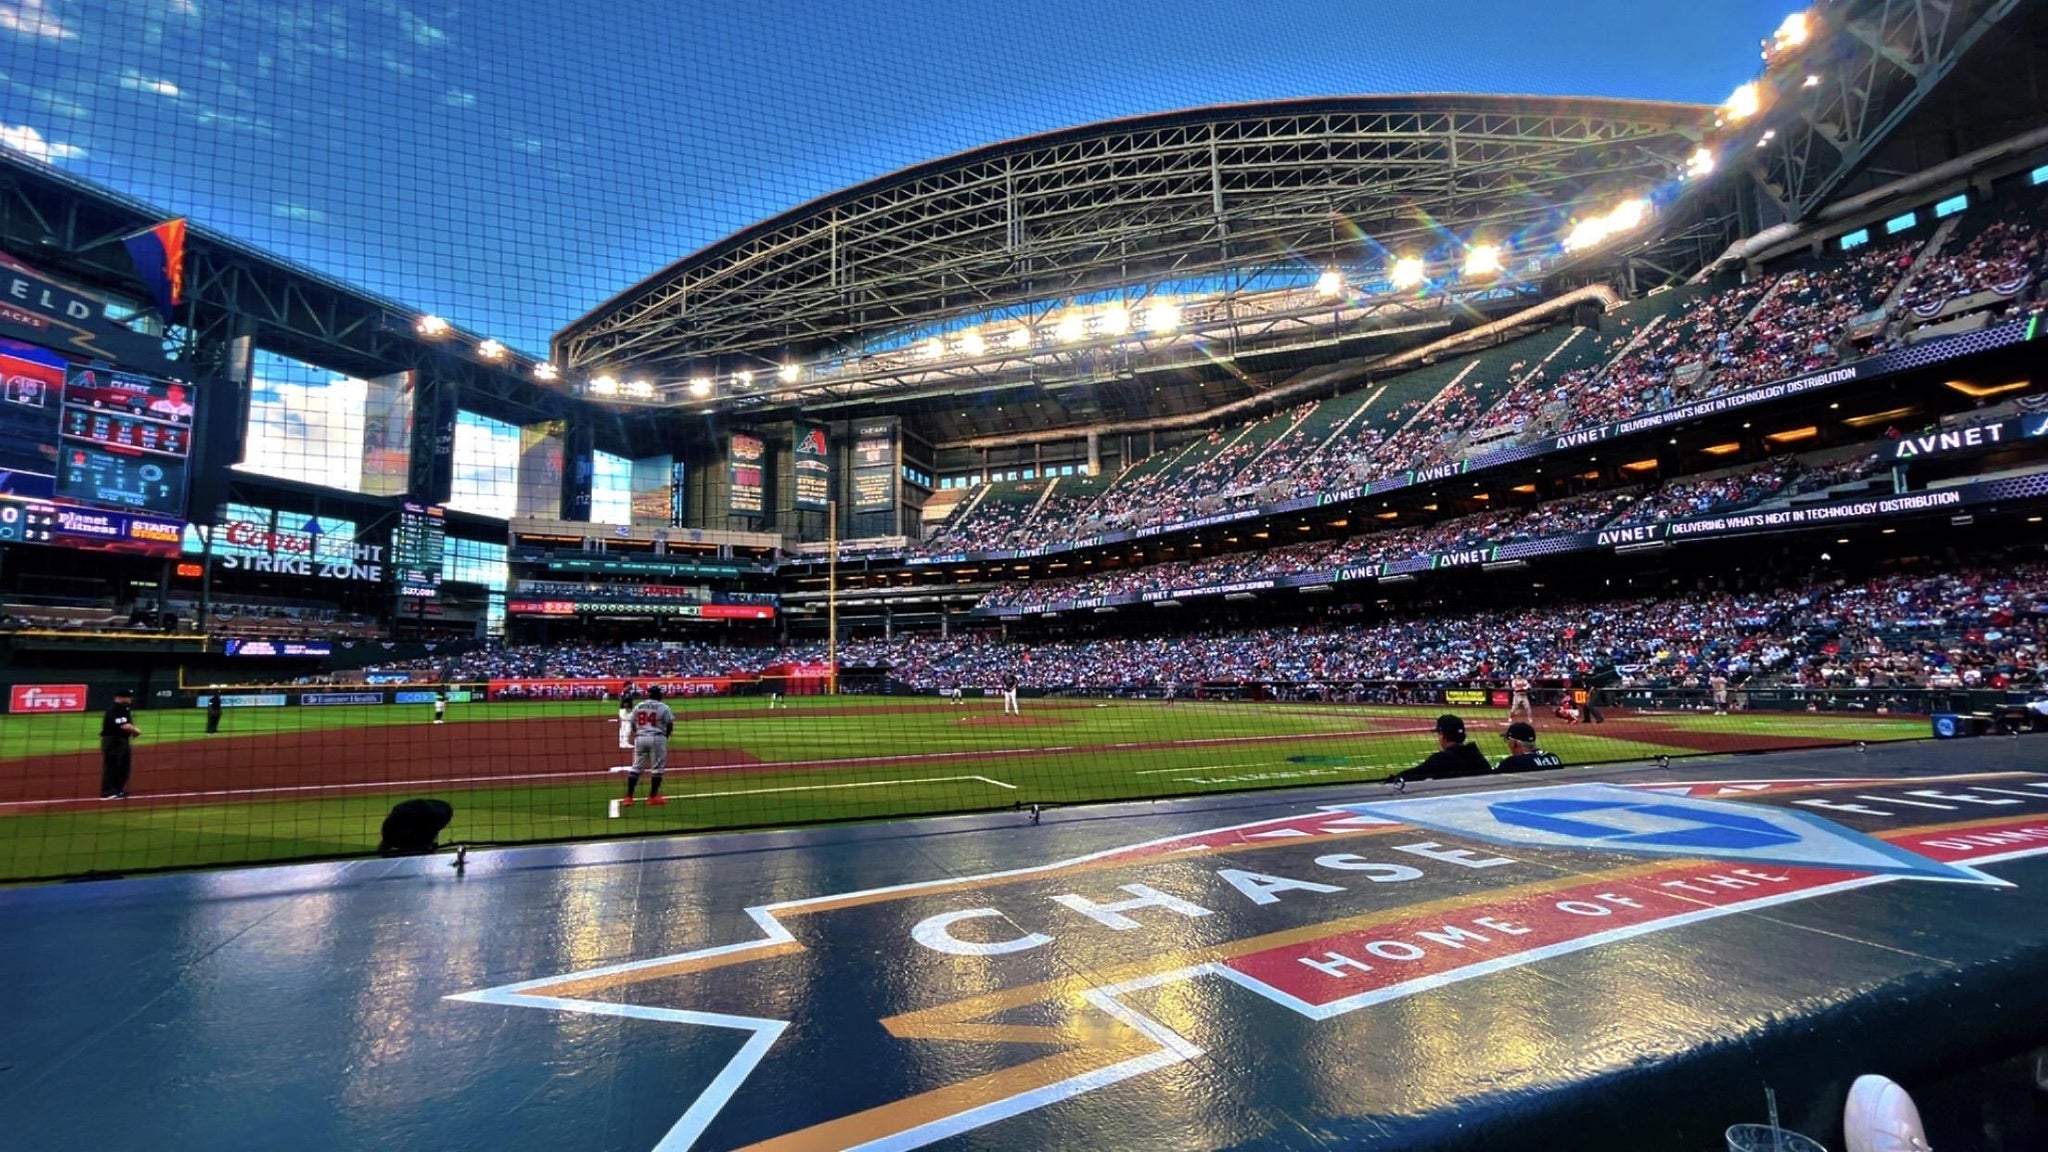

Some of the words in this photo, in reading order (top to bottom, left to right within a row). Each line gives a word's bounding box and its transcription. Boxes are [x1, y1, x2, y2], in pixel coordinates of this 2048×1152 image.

[1556, 426, 1610, 449] AVNET
[1620, 415, 1662, 433] DELIVERING
[1664, 405, 1694, 422] WHAT'S
[1695, 401, 1715, 415] NEXT
[1716, 399, 1726, 410] IN
[1727, 384, 1785, 407] TECHNOLOGY
[1787, 367, 1856, 393] DISTRIBUTION
[1896, 424, 2003, 457] AVNET
[1417, 462, 1461, 483] AVNET
[1323, 487, 1362, 504] AVNET
[132, 521, 180, 534] START
[1598, 525, 1658, 545] AVNET
[1672, 519, 1725, 534] DELIVERING
[1726, 515, 1763, 528] WHAT'S
[1765, 512, 1791, 524] NEXT
[1793, 511, 1804, 522] IN
[1806, 502, 1877, 520] TECHNOLOGY
[1880, 491, 1959, 512] DISTRIBUTION
[222, 551, 312, 576] STRIKE
[318, 562, 382, 582] ZONE
[1440, 549, 1490, 567] AVNET
[1341, 564, 1381, 580] AVNET
[19, 687, 78, 708] fry's
[637, 711, 656, 727] 84
[911, 842, 1517, 955] CHASE
[1298, 916, 1533, 978] HOME
[1556, 893, 1644, 917] OF
[1661, 867, 1791, 896] THE
